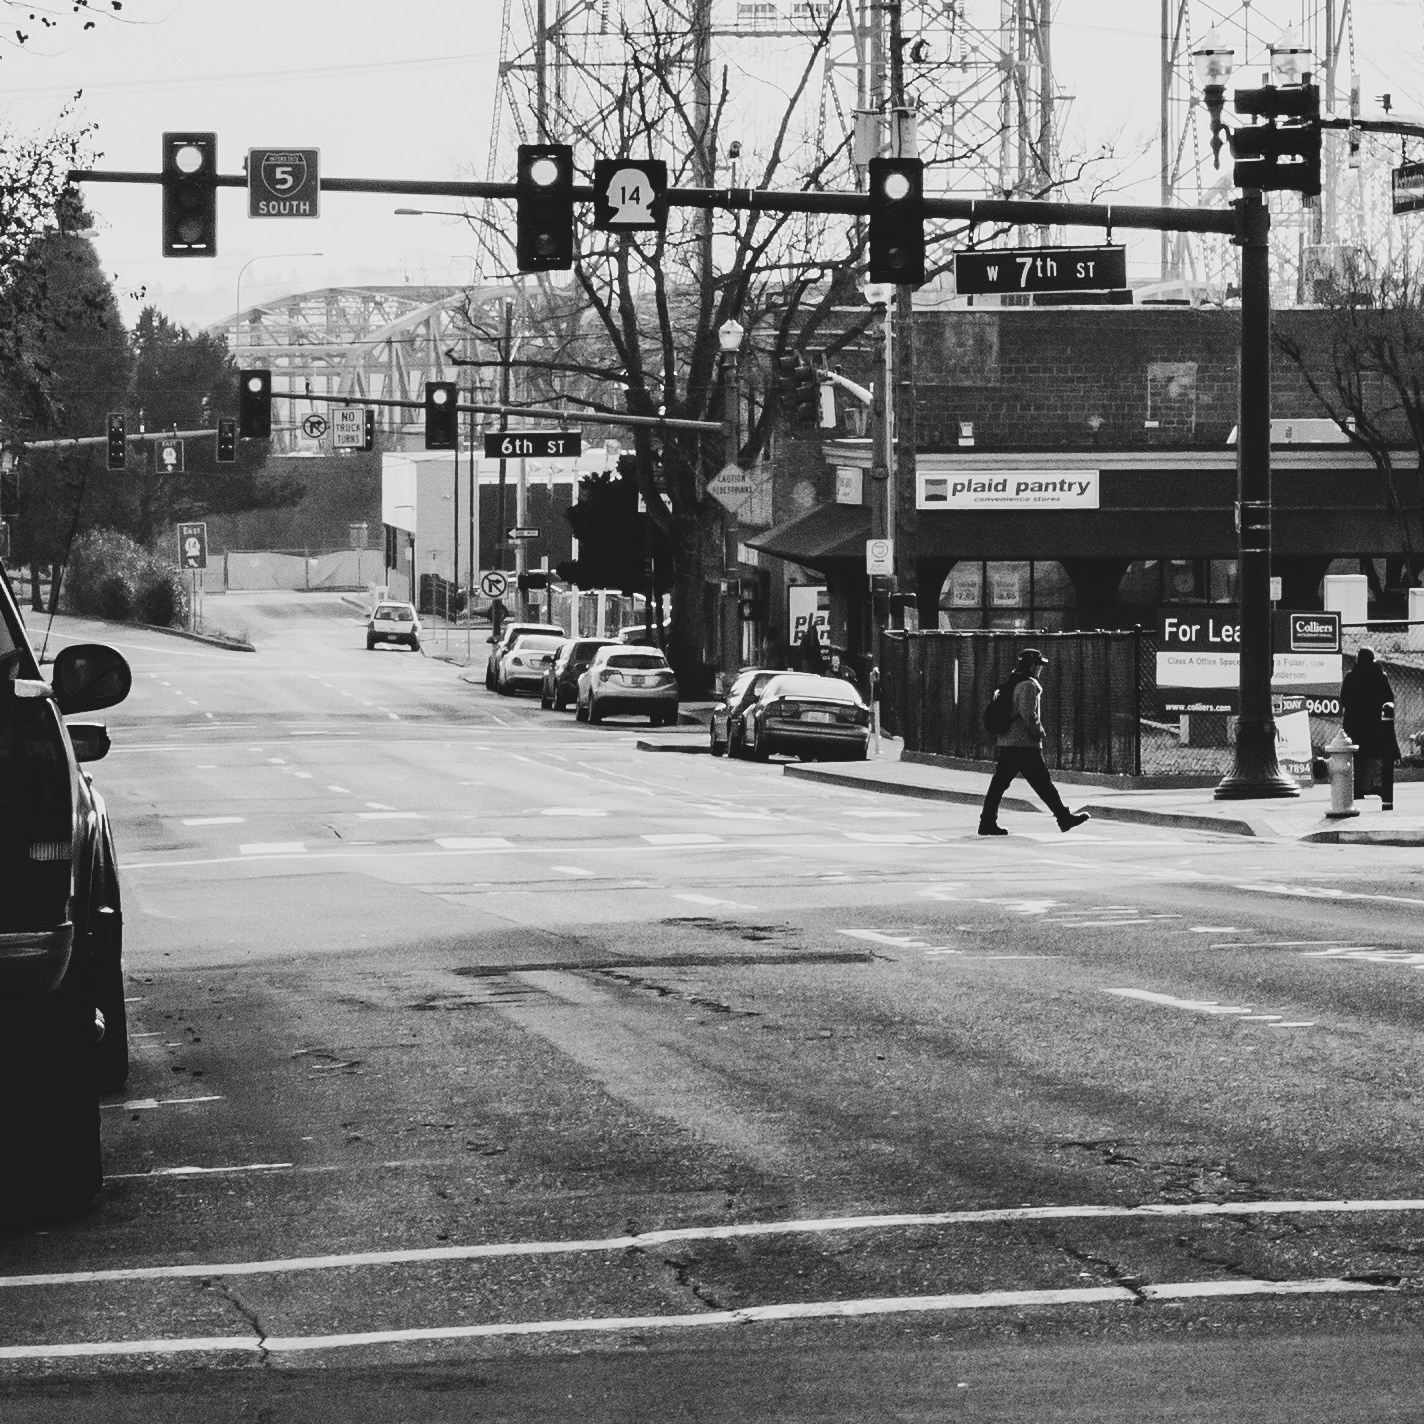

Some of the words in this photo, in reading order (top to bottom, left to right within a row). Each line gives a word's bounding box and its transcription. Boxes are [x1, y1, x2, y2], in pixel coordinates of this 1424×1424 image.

[275, 166, 294, 189] 5
[620, 185, 641, 205] 14
[259, 200, 310, 214] SOUTH
[986, 265, 999, 282] W
[1015, 257, 1057, 288] 7th
[1076, 261, 1095, 278] ST
[341, 412, 355, 422] NO
[501, 438, 533, 454] 6th
[547, 440, 565, 454] ST
[952, 478, 1008, 496] plaid
[1015, 478, 1091, 496] pantry
[794, 612, 828, 630] pla
[1295, 621, 1333, 633] Colliers
[1165, 618, 1200, 642] For
[1209, 618, 1240, 643] Lea
[1167, 657, 1186, 665] Class
[1306, 699, 1340, 714] 9600
